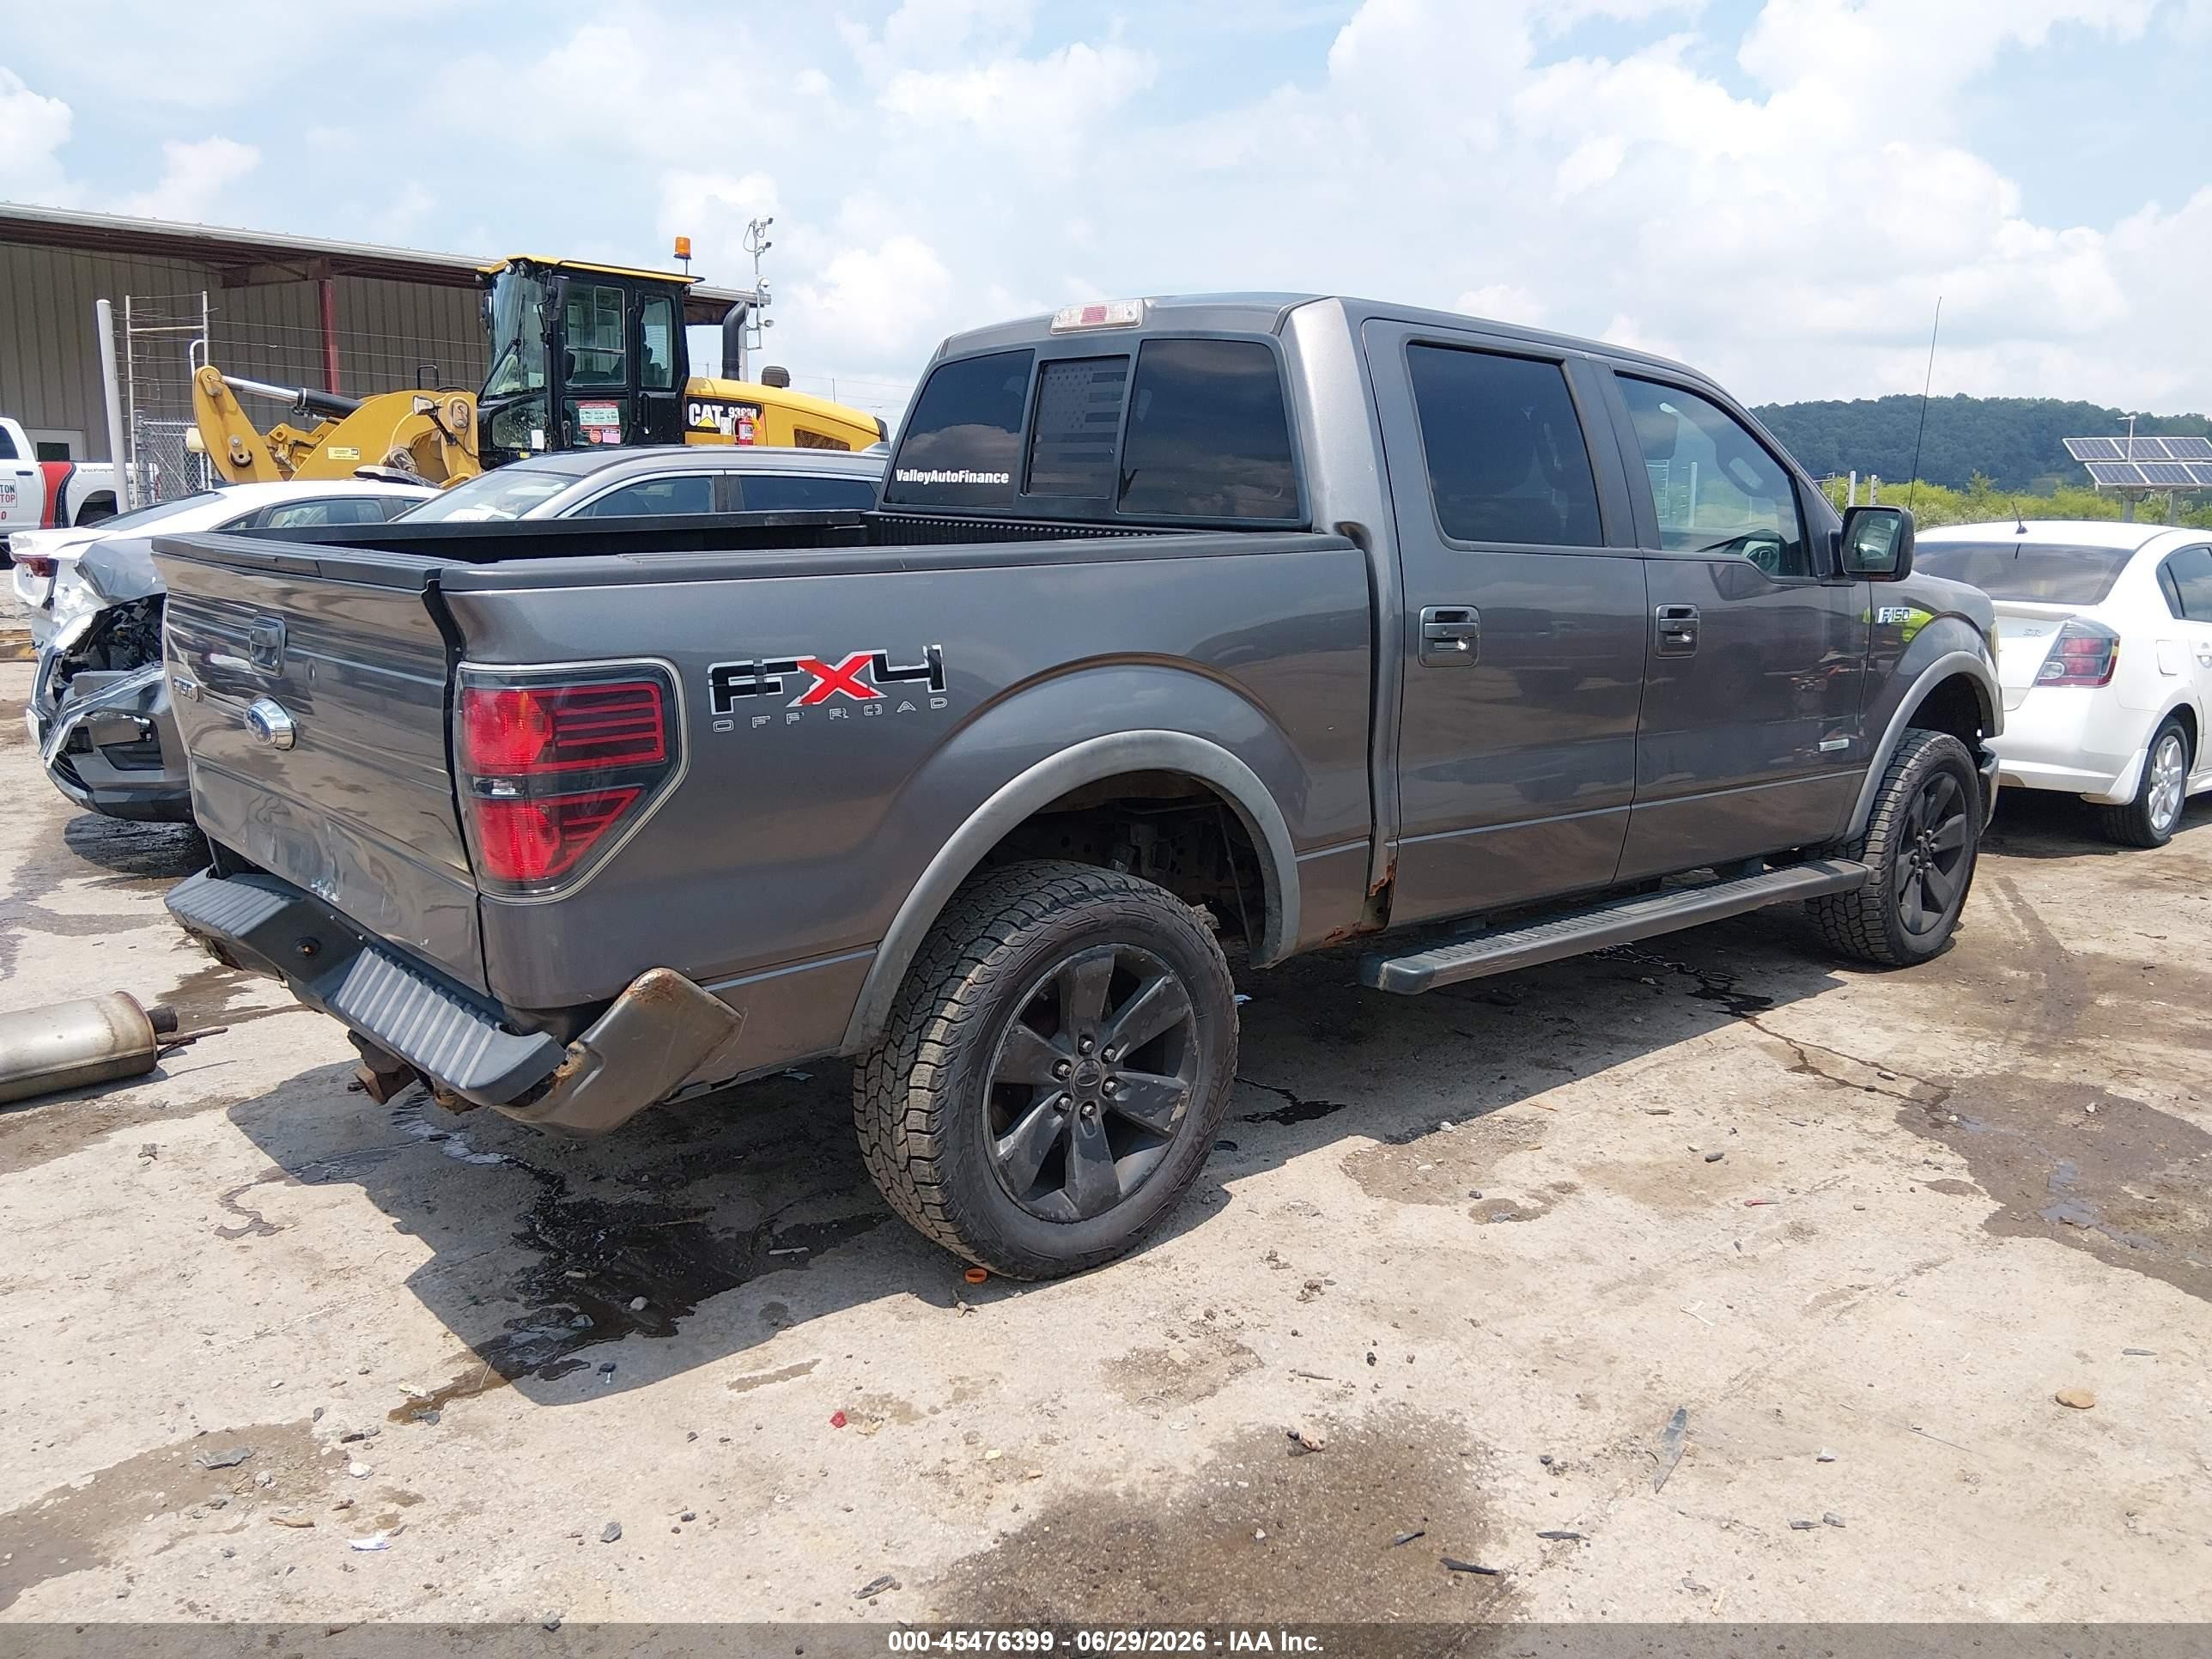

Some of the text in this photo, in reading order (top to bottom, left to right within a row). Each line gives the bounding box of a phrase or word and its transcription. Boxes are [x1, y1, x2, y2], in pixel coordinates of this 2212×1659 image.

[689, 404, 723, 428] CAT
[896, 469, 1009, 485] ValleyAutoFinance
[708, 644, 946, 715] FX4
[713, 697, 948, 732] OFF ROAD
